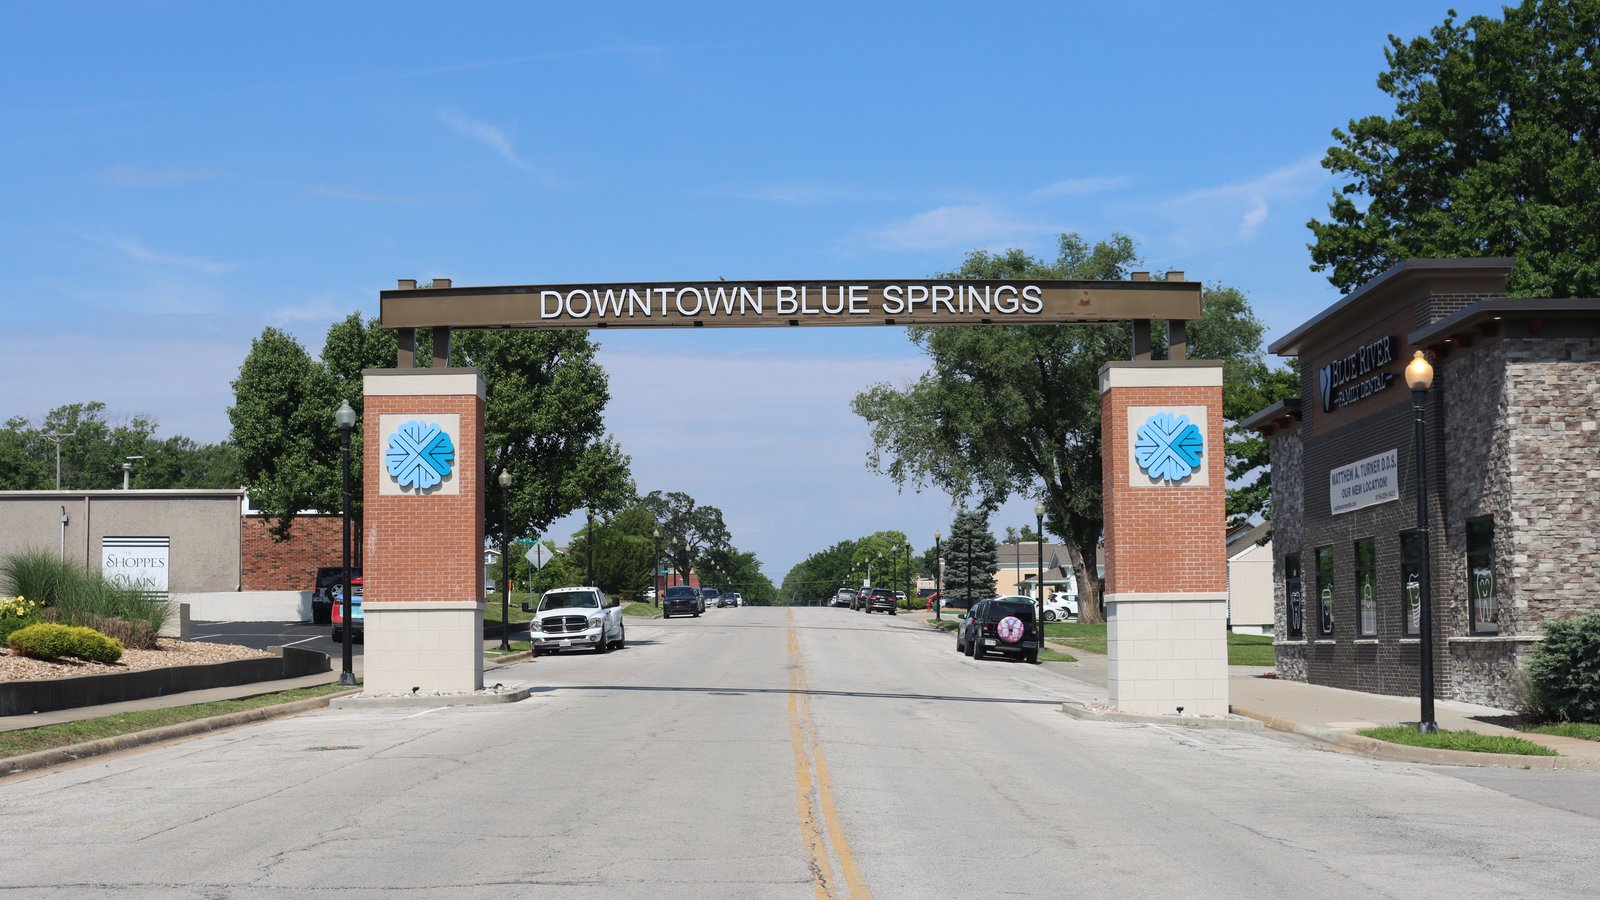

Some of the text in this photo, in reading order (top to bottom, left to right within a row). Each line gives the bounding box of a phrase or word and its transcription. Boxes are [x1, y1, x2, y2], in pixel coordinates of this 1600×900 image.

[540, 285, 1043, 319] DOWNTOWN BLUE SPRINGS
[1332, 336, 1392, 388] BLUE RIVER
[1339, 373, 1386, 407] FAMILY DENTAL
[1332, 468, 1354, 486] MATTHEW
[1360, 459, 1381, 477] TURNER
[1342, 487, 1351, 499] OUR
[1352, 484, 1362, 495] NEW
[106, 554, 165, 567] SHOPPES
[114, 574, 156, 587] MAIN
